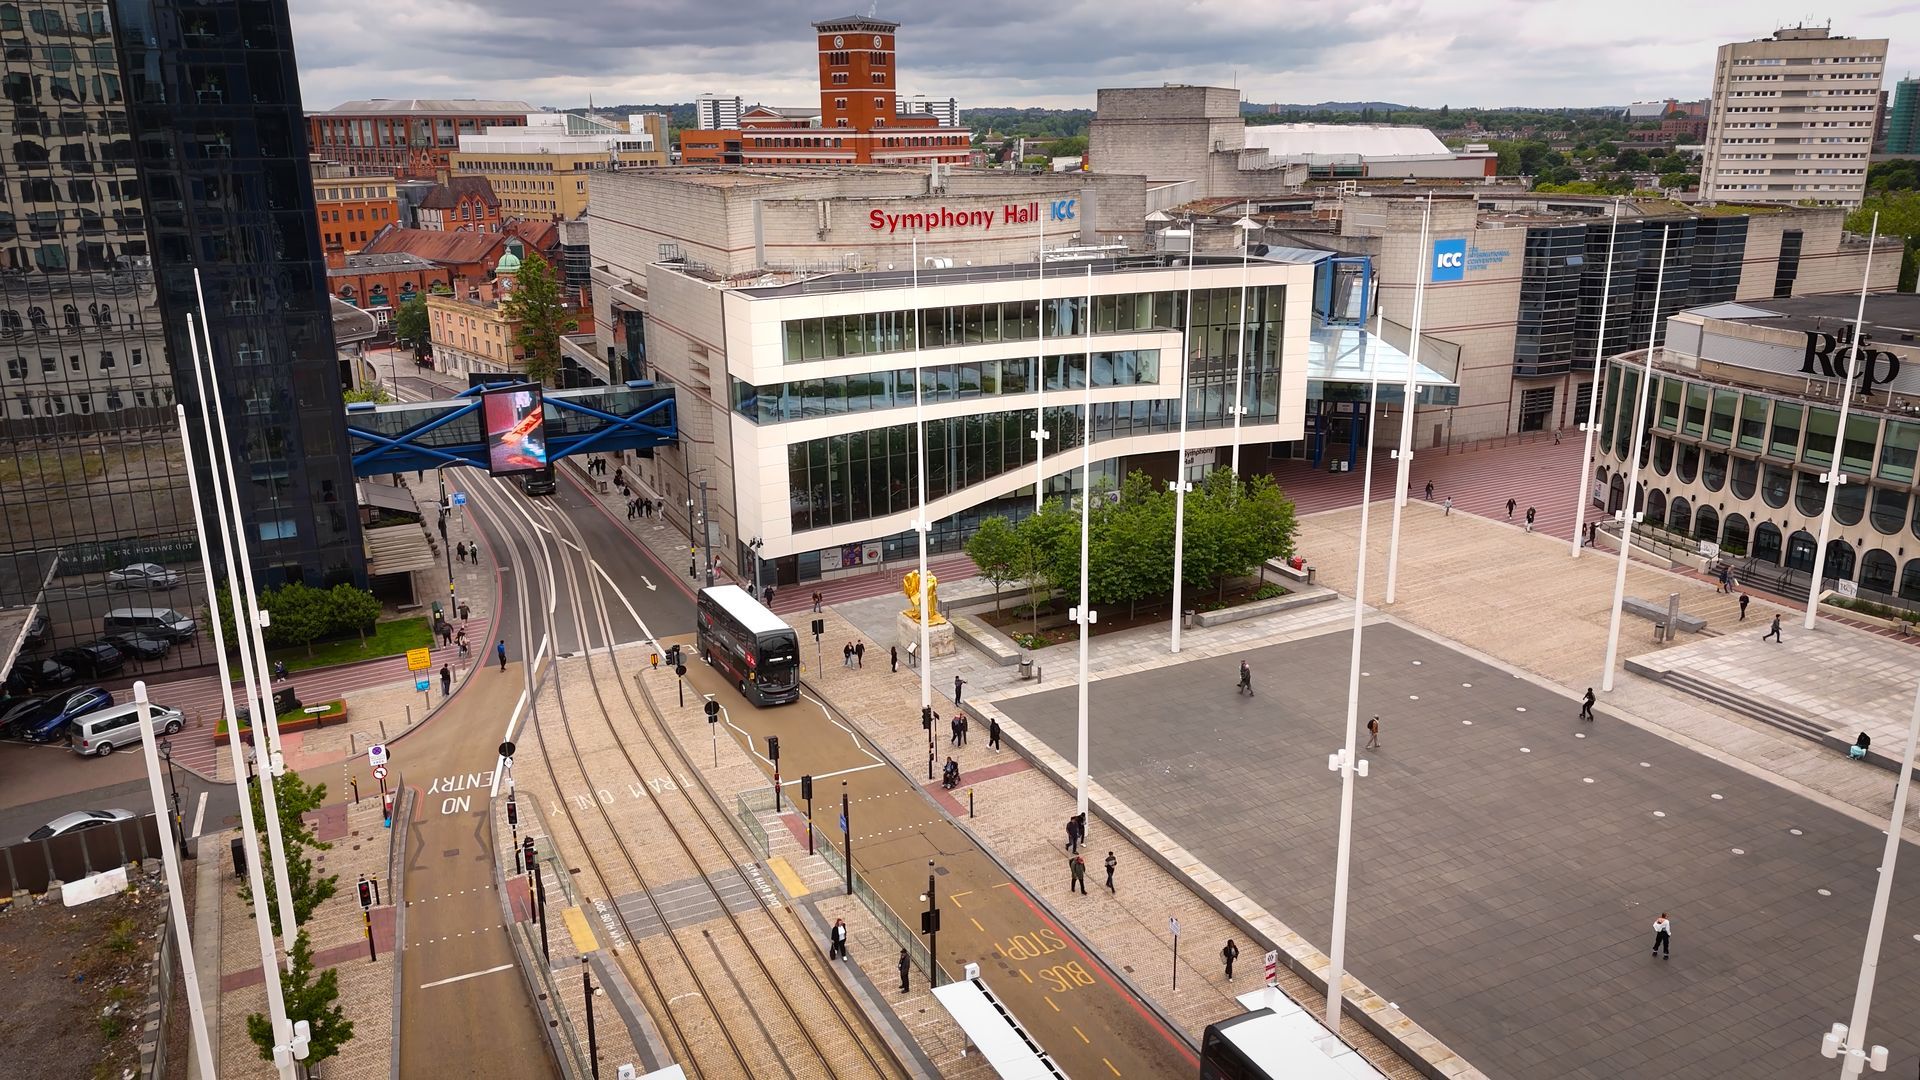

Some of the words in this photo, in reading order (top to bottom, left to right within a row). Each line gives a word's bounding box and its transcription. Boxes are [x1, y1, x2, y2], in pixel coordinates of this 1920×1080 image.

[869, 207, 995, 233] Symphony
[1004, 202, 1039, 224] Hall
[1050, 199, 1076, 221] ICC
[1437, 252, 1463, 268] ICC
[1797, 331, 1900, 396] Rep
[427, 770, 495, 795] ENTRY
[628, 773, 696, 799] TRAM
[441, 795, 471, 815] NO
[551, 789, 615, 817] ONLY
[754, 877, 772, 893] BOTH
[600, 913, 617, 931] BOTH
[1007, 928, 1067, 960] STOP
[1039, 961, 1096, 992] BUS
